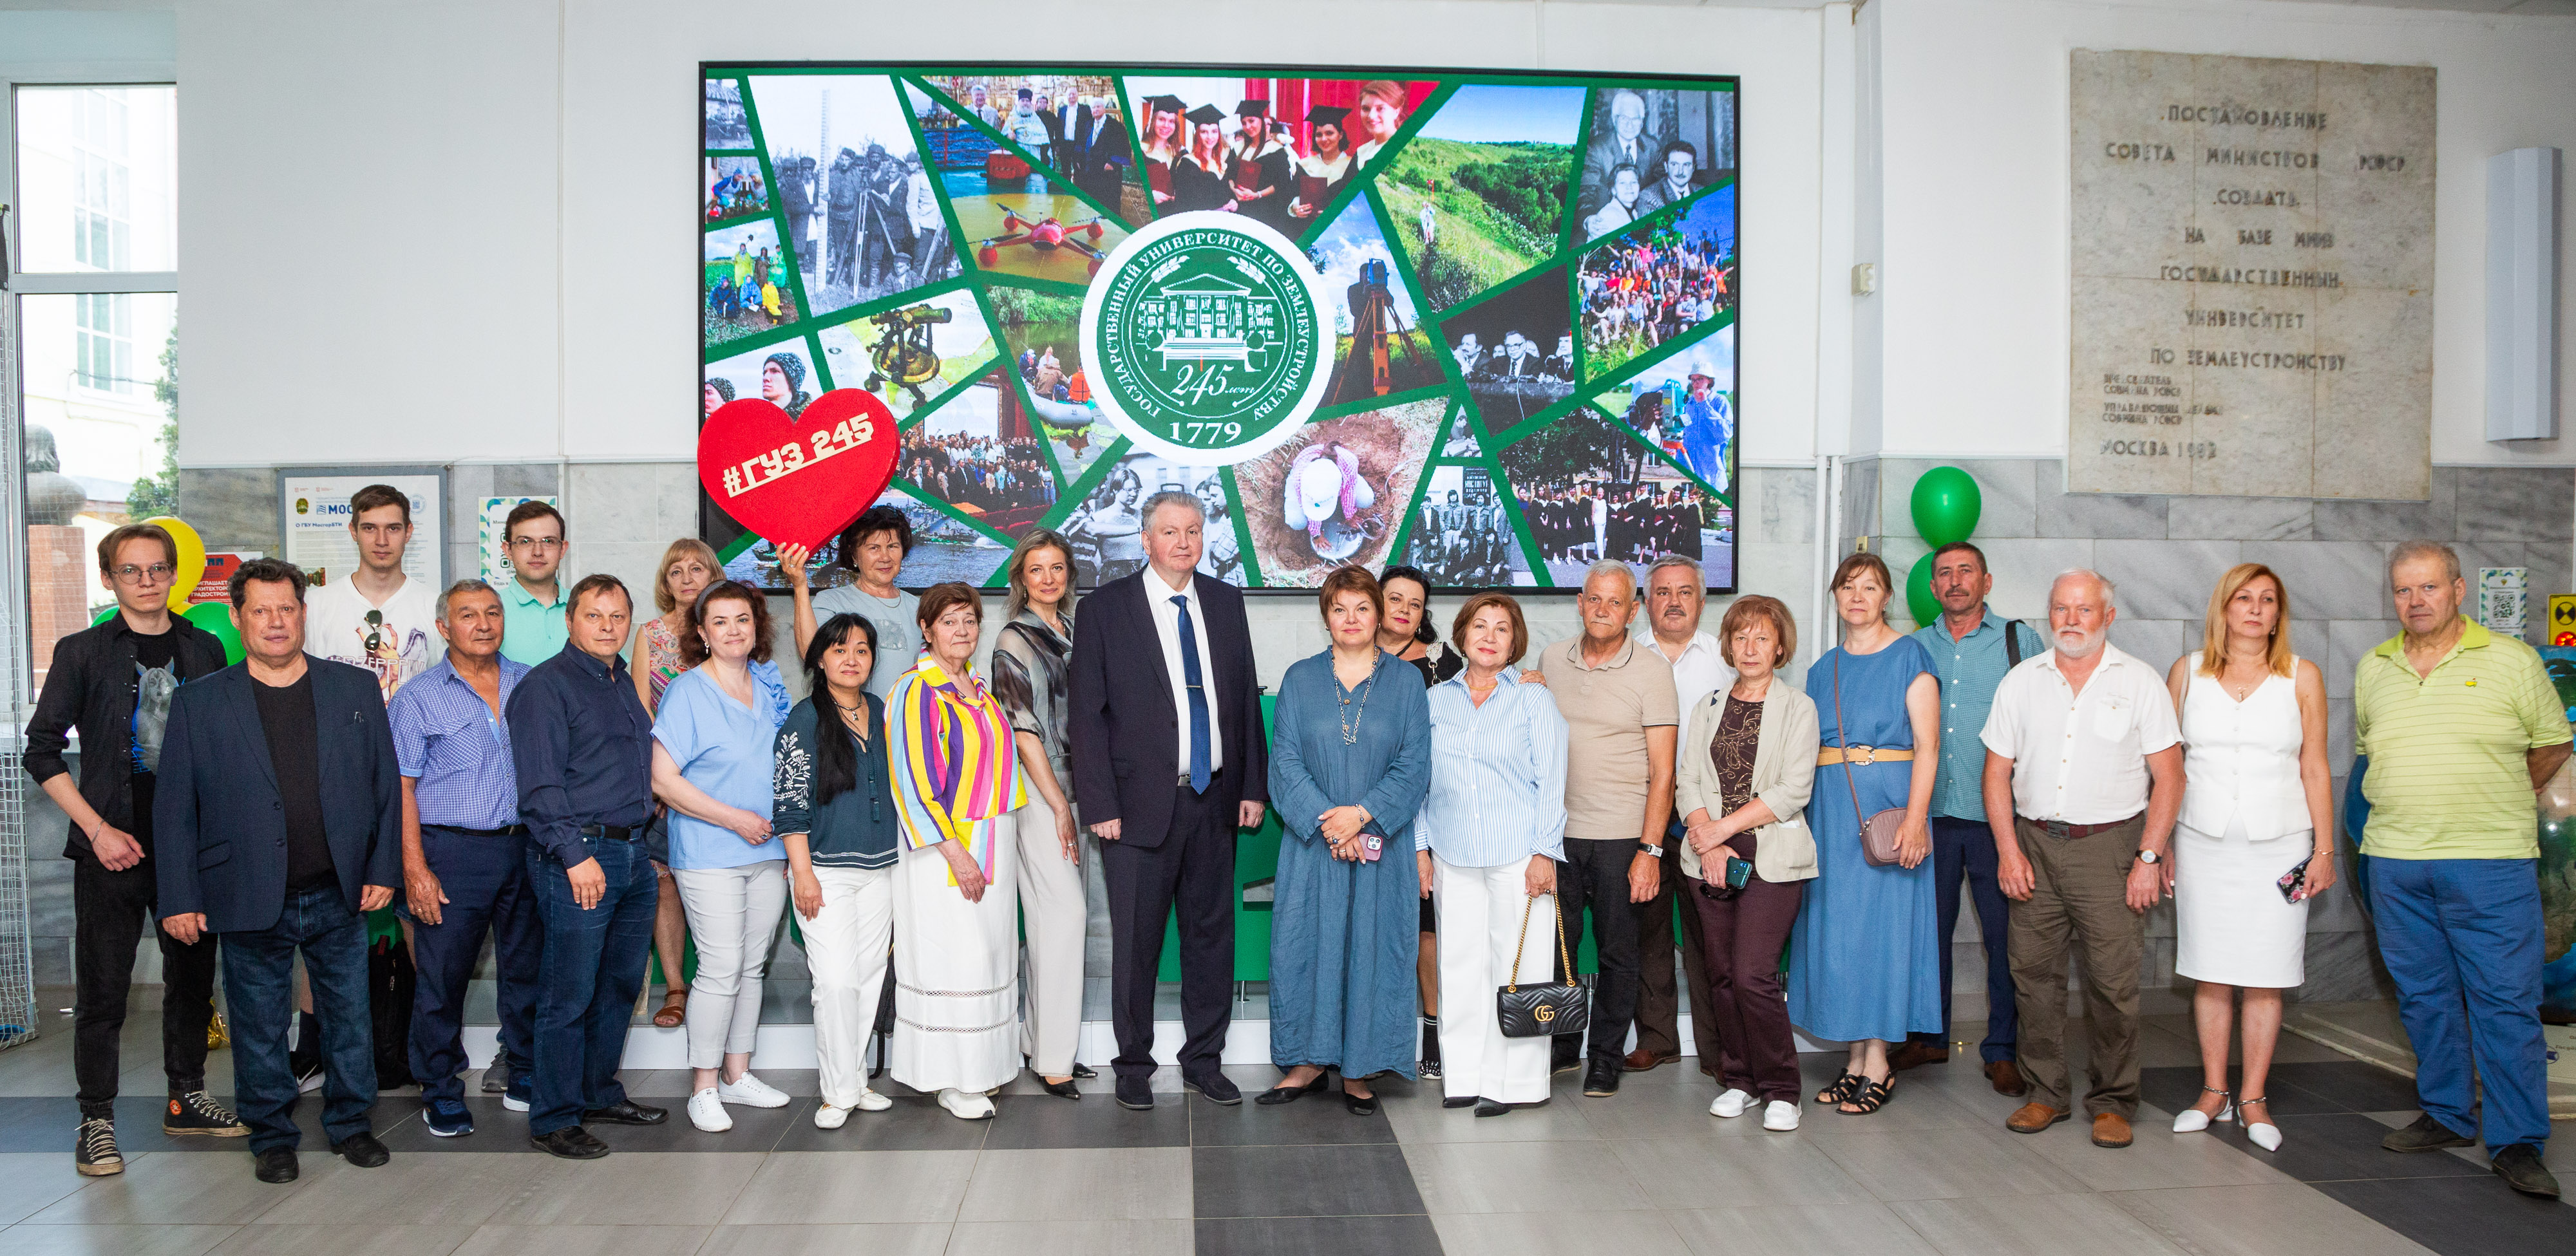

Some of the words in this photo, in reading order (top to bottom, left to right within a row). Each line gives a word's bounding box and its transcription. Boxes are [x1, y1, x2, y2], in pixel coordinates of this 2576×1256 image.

[2105, 142, 2175, 162] СОВЕТА
[2206, 147, 2319, 169] МИНИСТРОВ
[1138, 232, 1264, 267] УНИВЕРСИТЕТ
[2184, 227, 2205, 245] НА
[2238, 229, 2272, 246] БАЗЕ
[1262, 253, 1284, 275] ПО
[1106, 263, 1162, 418] ГОСУДАРСТВЕННЫЙ
[1253, 274, 1309, 421] ЗЕМЛЕУСТРОЙСТВУ
[2150, 348, 2175, 365] ПО
[1170, 364, 1235, 406] 245
[1170, 422, 1242, 445] 1779
[722, 442, 804, 498] #ГУЗ
[810, 412, 875, 458] 245
[2100, 439, 2170, 456] МОСКВА
